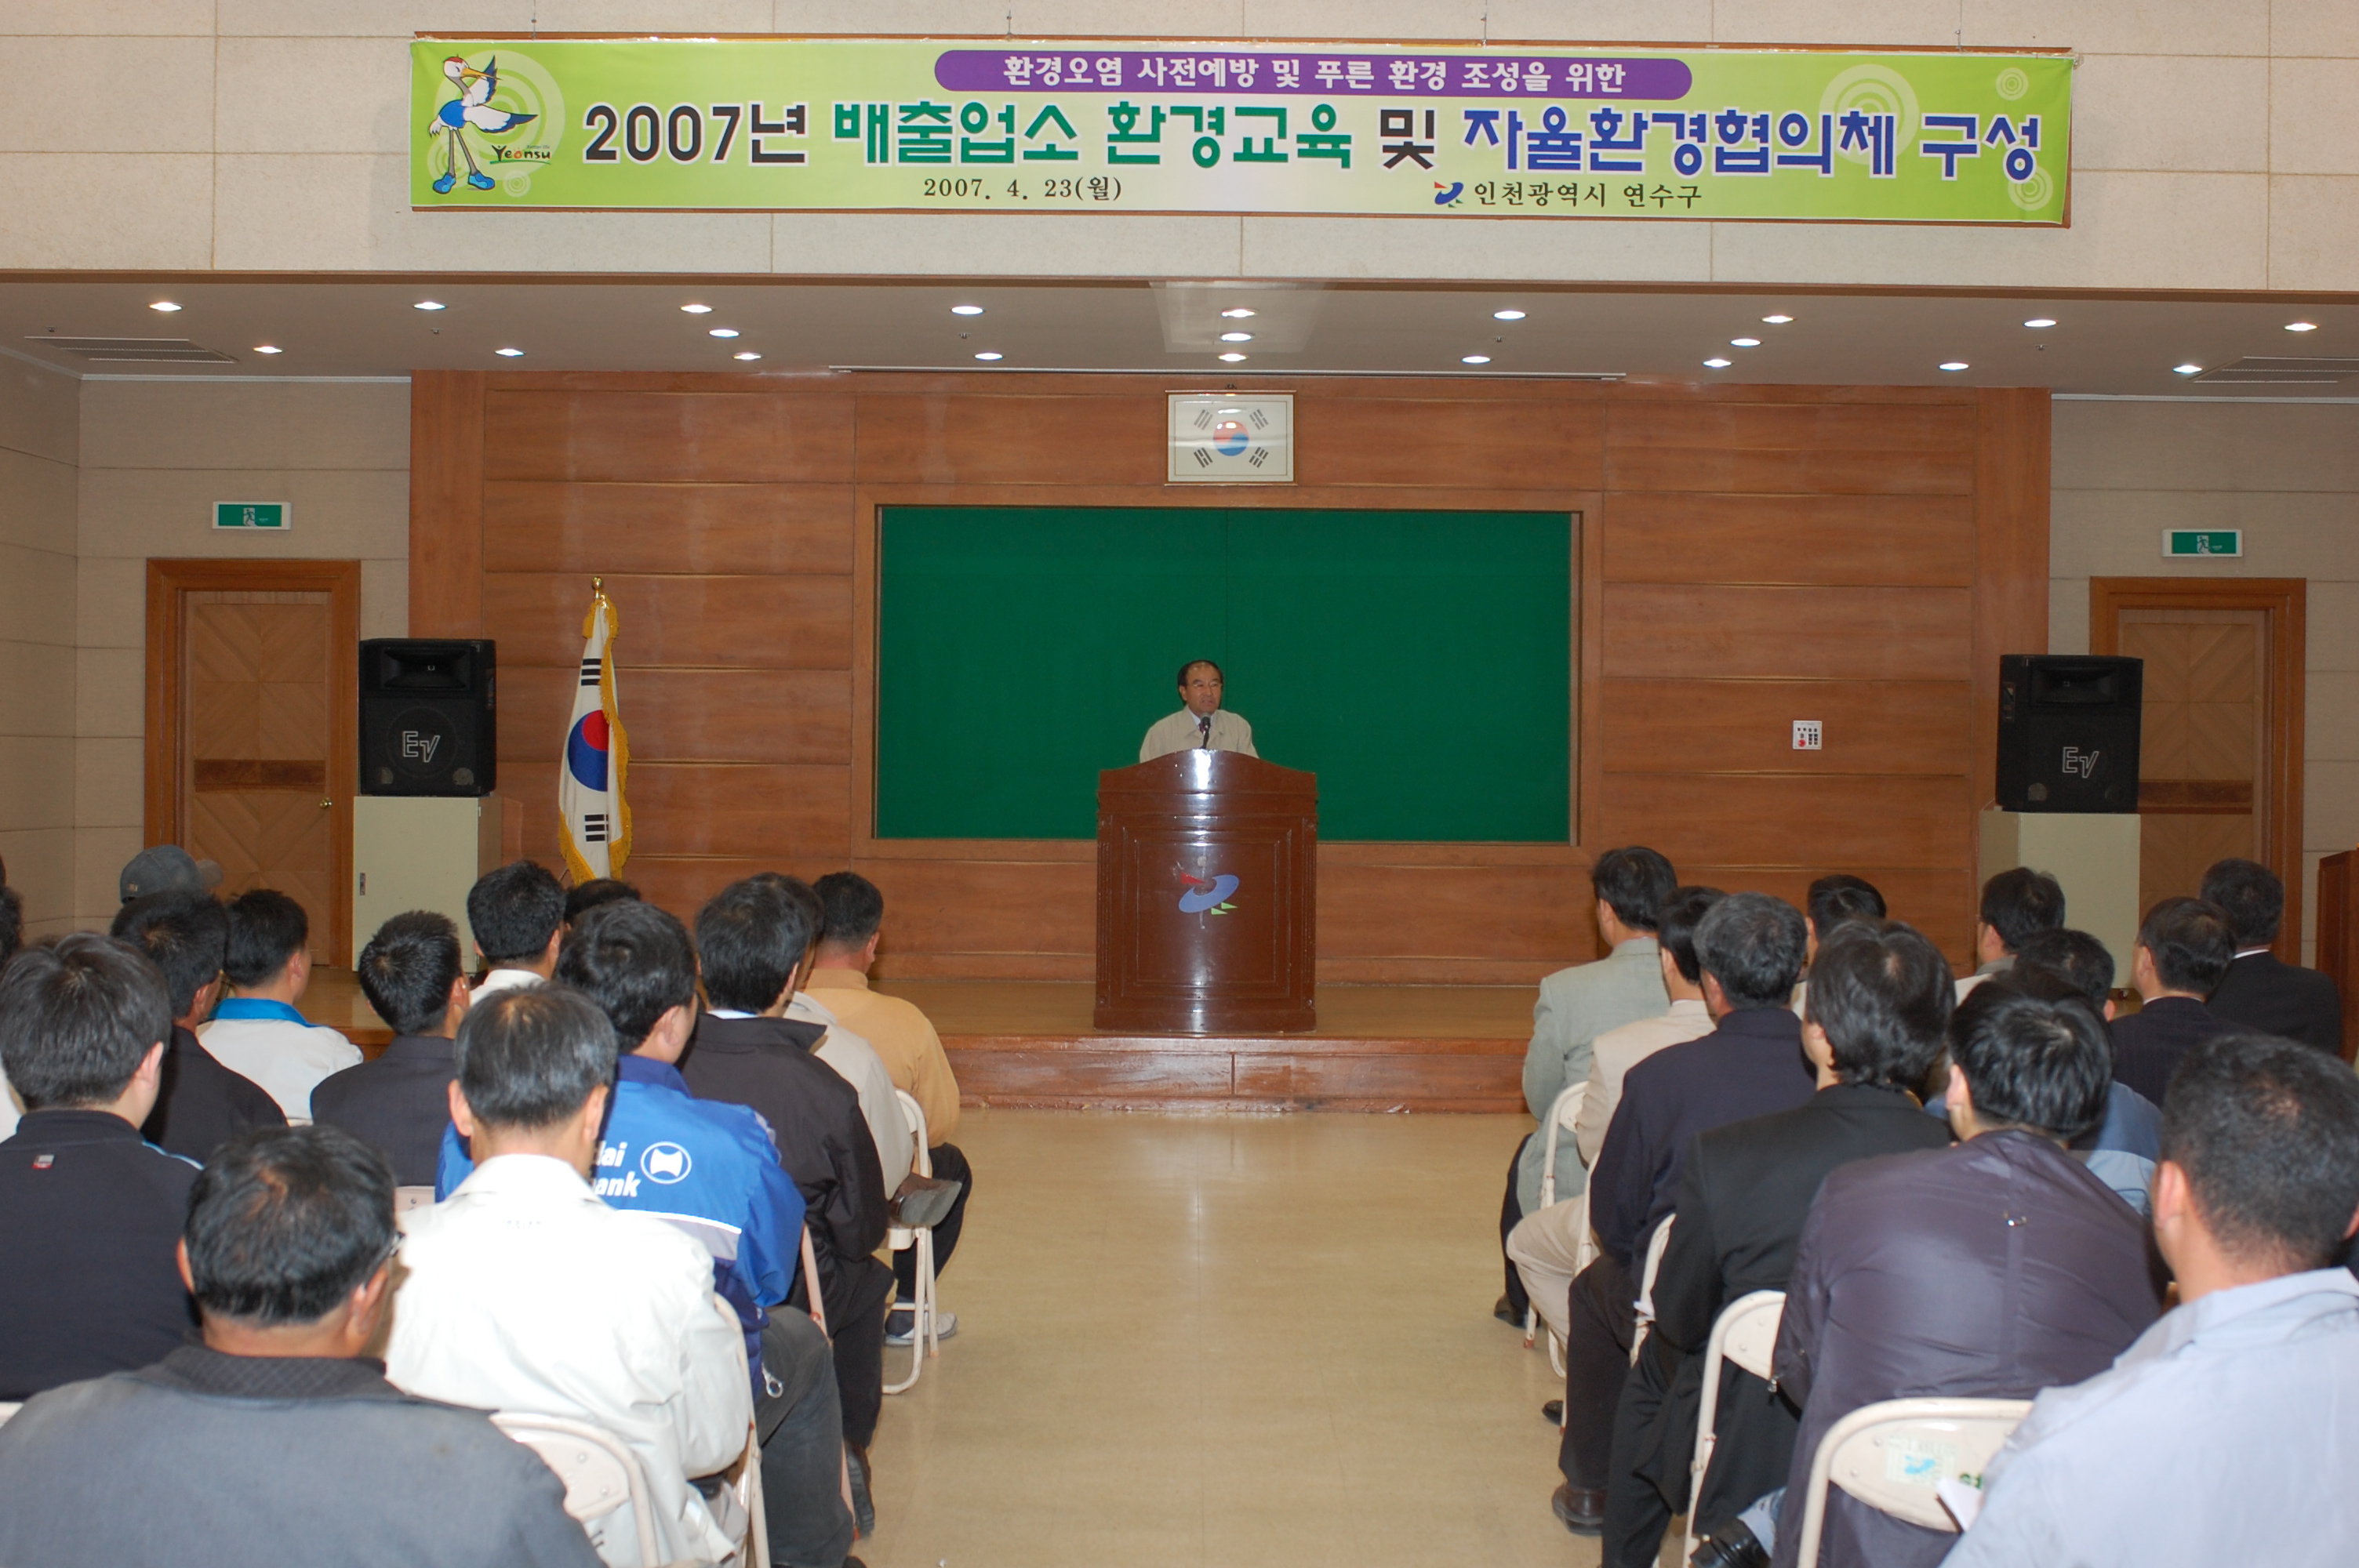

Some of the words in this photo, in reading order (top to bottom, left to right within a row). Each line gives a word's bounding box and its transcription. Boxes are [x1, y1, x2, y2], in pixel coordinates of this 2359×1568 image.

[1003, 56, 1123, 87] 환경오염
[1136, 57, 1259, 89] 사전예방
[1271, 59, 1301, 89] 및
[1314, 60, 1375, 89] 푸른
[1388, 60, 1447, 91] 환경
[1461, 61, 1552, 93] 조성을
[1565, 63, 1627, 93] 위한
[491, 144, 551, 162] Yeonsu
[585, 103, 806, 163] 2007년
[834, 100, 1079, 164] 배출업소
[1107, 100, 1352, 169] 환경교육
[1379, 109, 1435, 170] 및
[1463, 106, 1895, 176] 자율환경협의체
[1922, 115, 2039, 181] 구성
[924, 178, 990, 201] 2007.
[1007, 178, 1028, 201] 4.
[1044, 176, 1122, 201] 23(월)
[1474, 180, 1606, 209] 인천광역시
[1623, 183, 1703, 209] 연수구
[594, 1171, 642, 1197] ank
